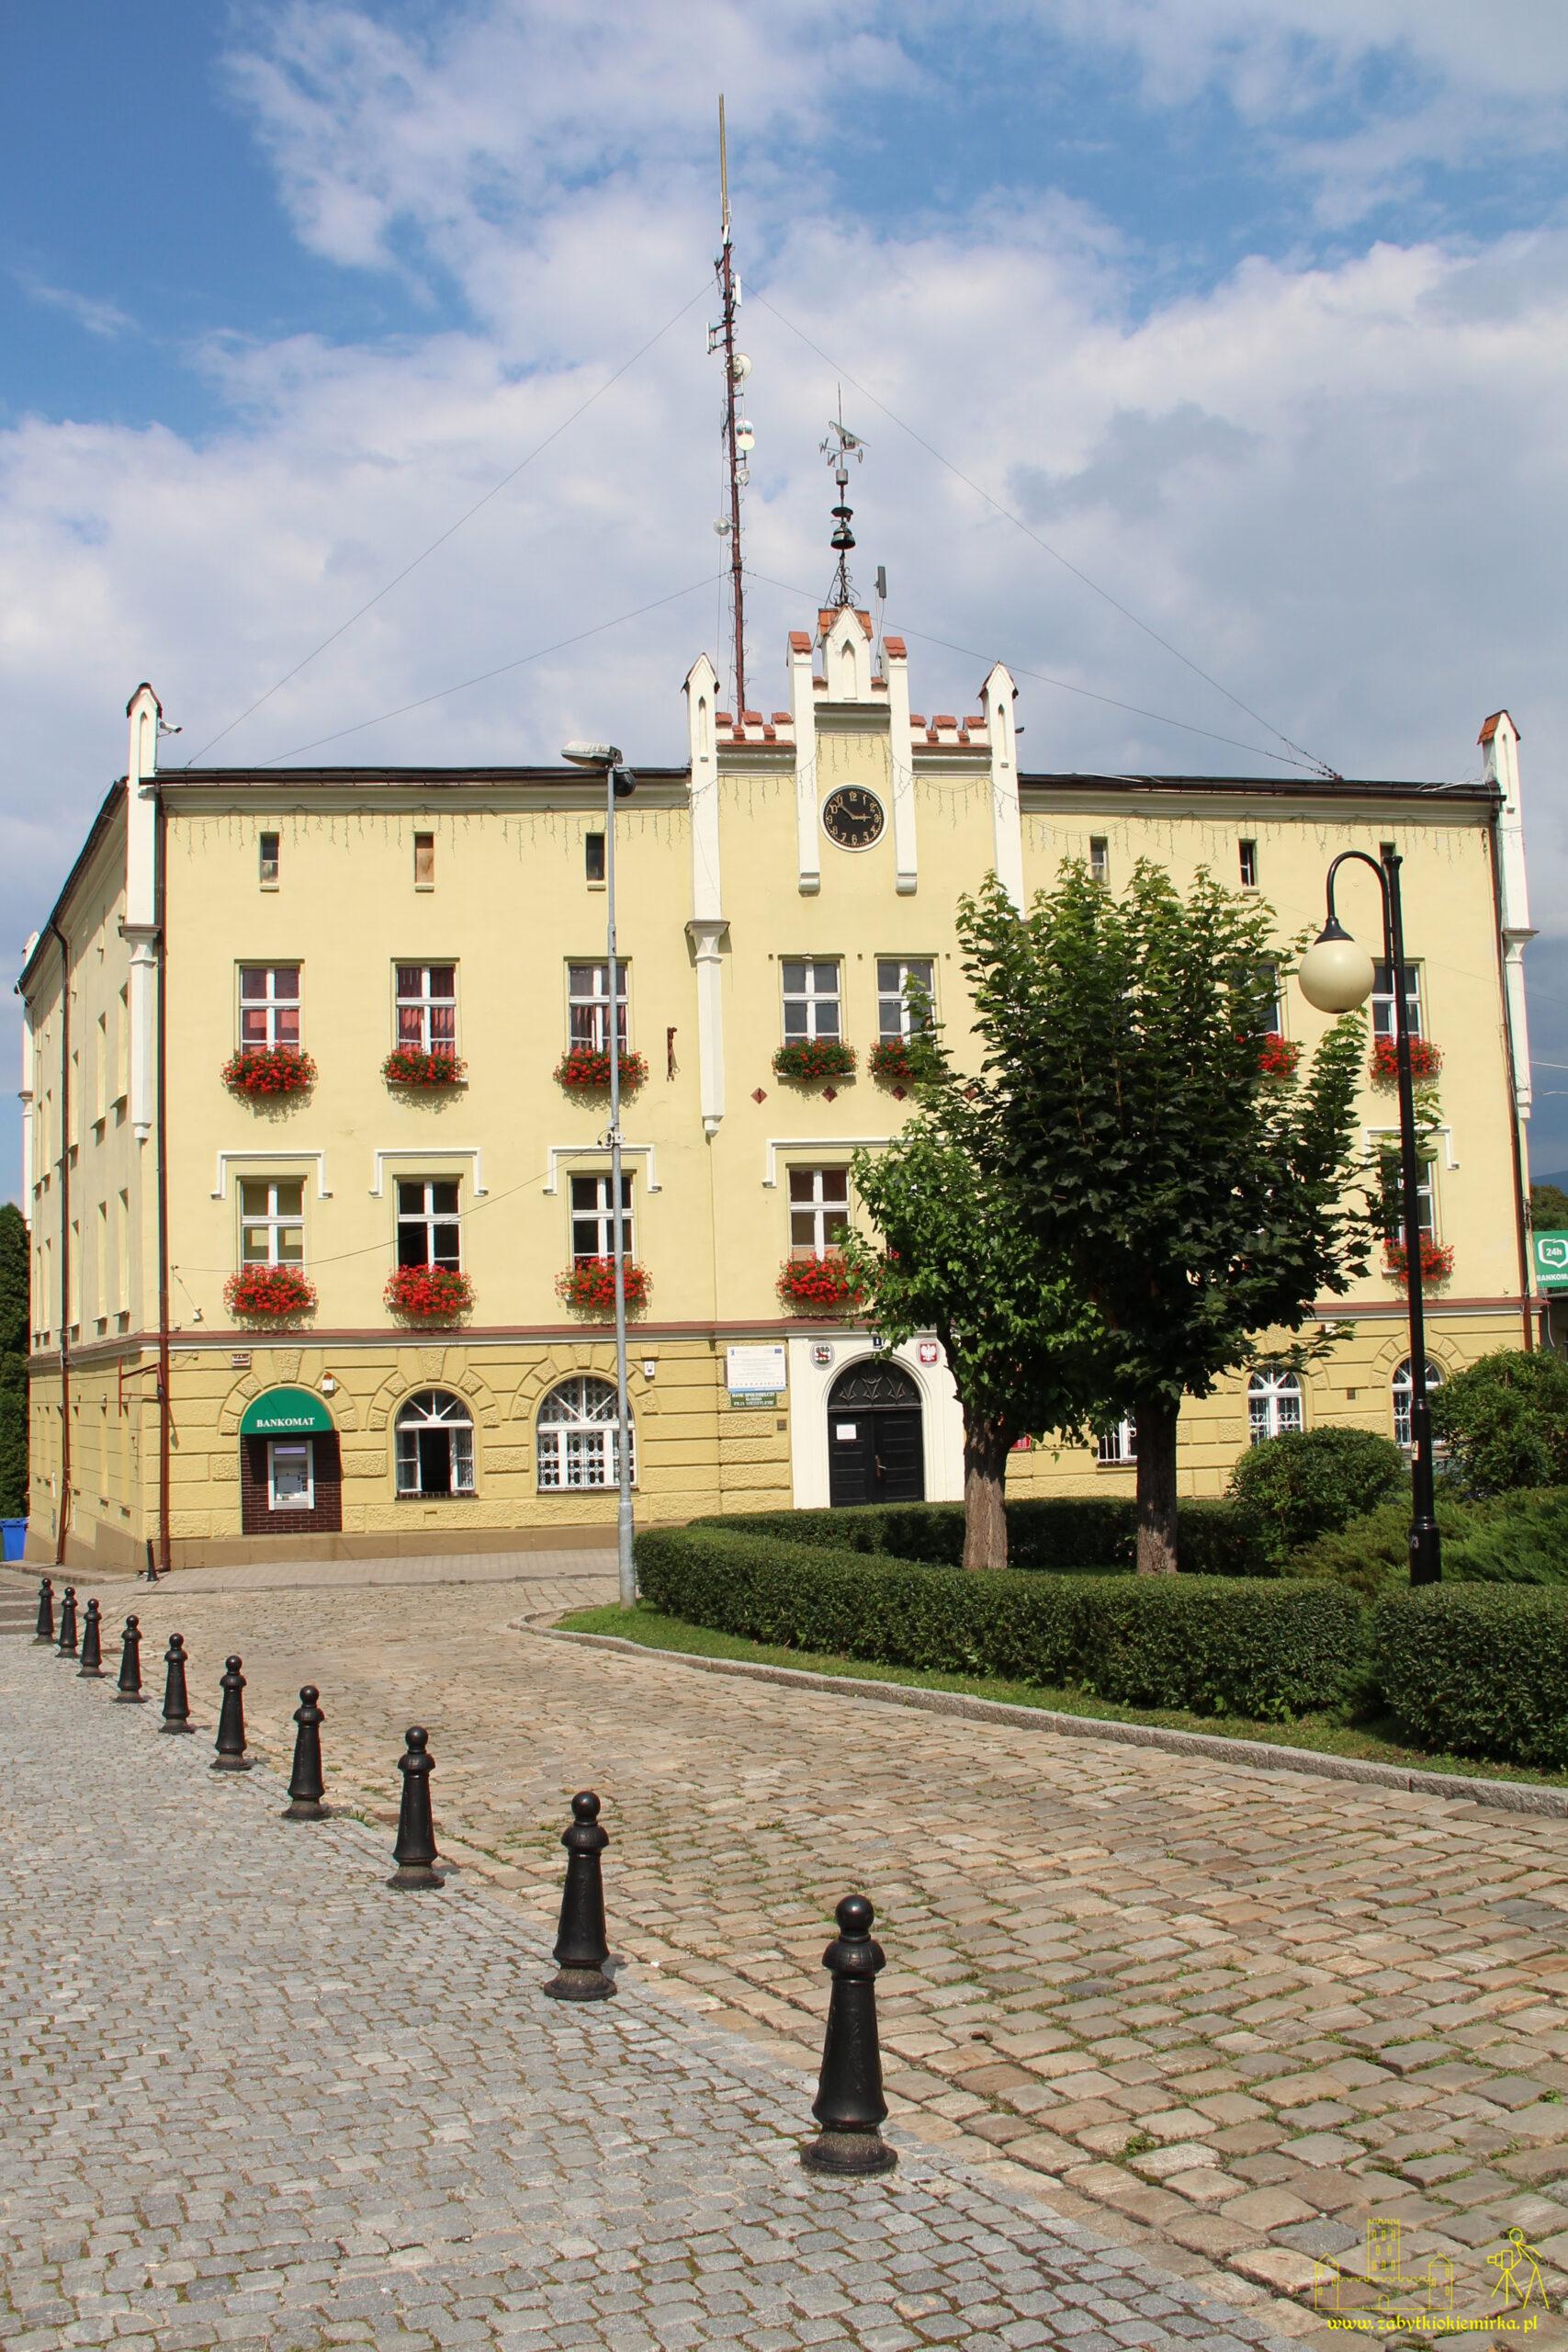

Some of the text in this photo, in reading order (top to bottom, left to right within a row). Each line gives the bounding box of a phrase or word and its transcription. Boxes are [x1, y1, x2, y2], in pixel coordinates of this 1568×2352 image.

[1545, 1248, 1563, 1257] 24h
[1537, 1273, 1568, 1282] BANKOM
[256, 1417, 315, 1428] BANKOMAT
